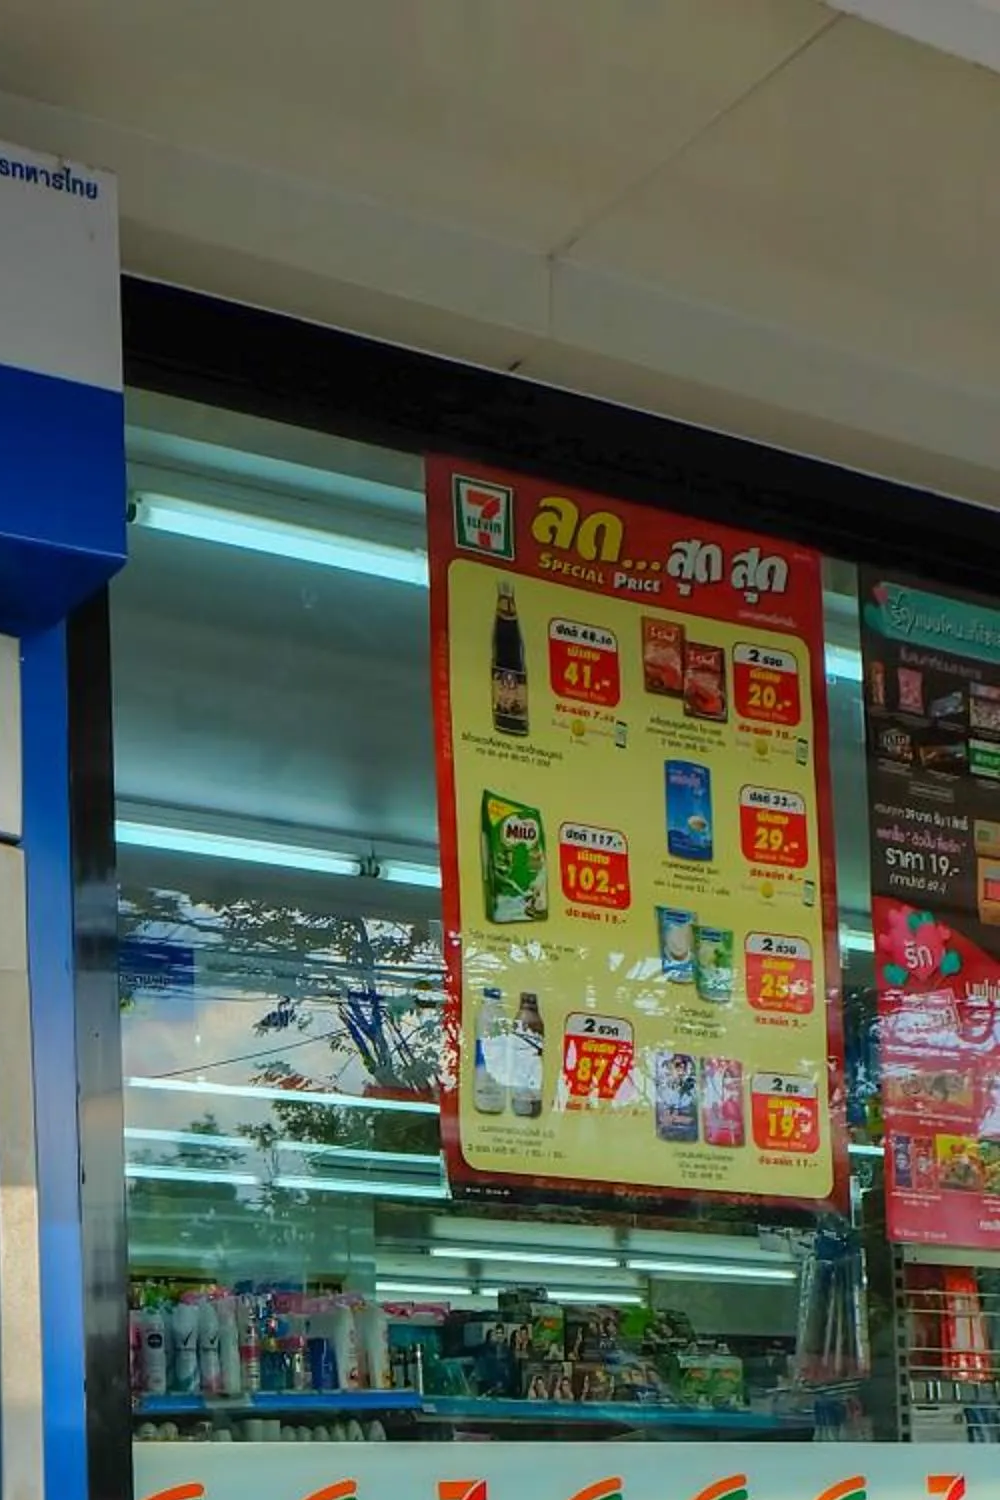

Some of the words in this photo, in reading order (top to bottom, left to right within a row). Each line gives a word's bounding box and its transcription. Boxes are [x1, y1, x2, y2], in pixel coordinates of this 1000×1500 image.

[748, 649, 761, 663] 2
[885, 848, 924, 871] ราคา
[929, 854, 960, 877] 19.-
[761, 938, 773, 951] 2
[904, 940, 933, 969] รัก
[584, 1019, 596, 1033] 2
[771, 1077, 783, 1091] 2
